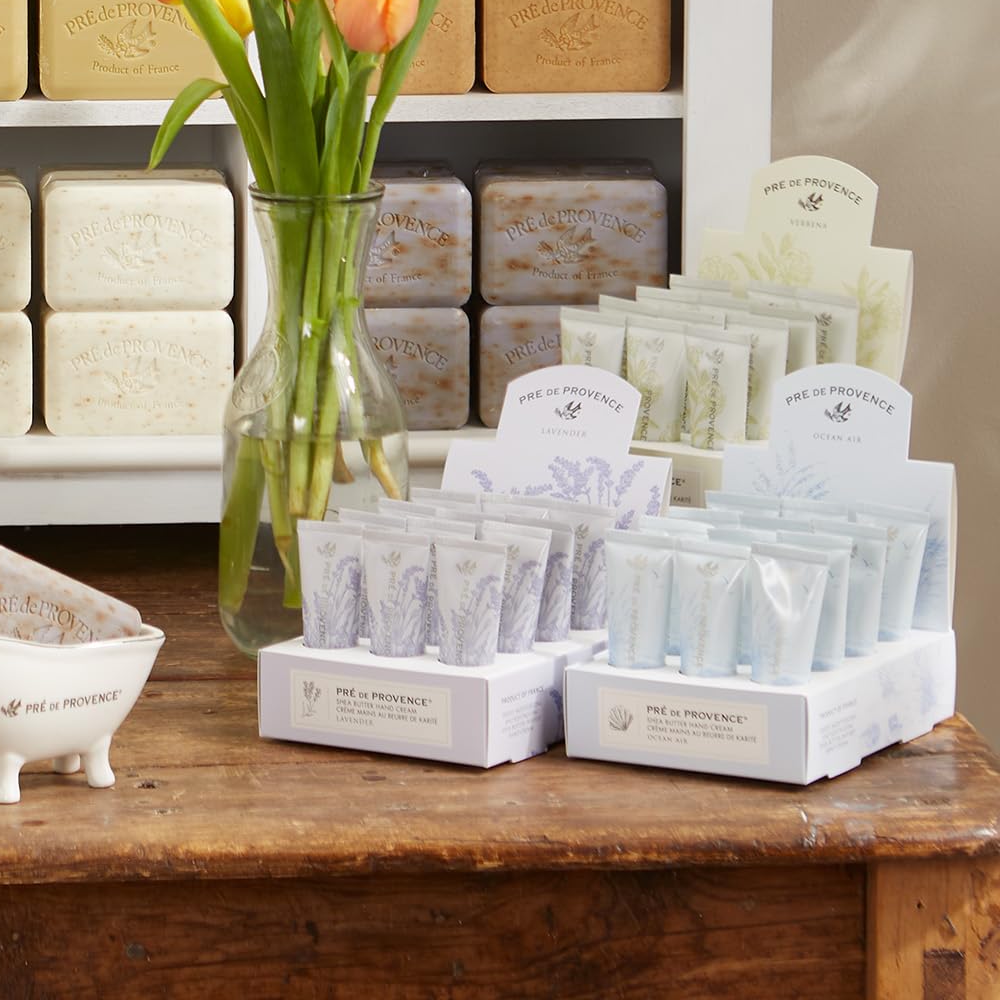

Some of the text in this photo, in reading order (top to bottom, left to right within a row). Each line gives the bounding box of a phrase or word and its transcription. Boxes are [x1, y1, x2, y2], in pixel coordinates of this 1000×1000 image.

[64, 10, 98, 35] PRÉ
[98, 6, 116, 21] de
[93, 60, 179, 74] Product of France
[536, 52, 620, 65] Product of France
[789, 178, 802, 188] DE
[804, 177, 863, 206] PROVENCE
[123, 214, 213, 249] PROVENCE
[539, 210, 554, 226] de
[557, 209, 646, 243] PROVENCE
[376, 273, 423, 283] of France
[533, 266, 618, 279] Product of France
[372, 336, 449, 371] ROVENCE
[546, 387, 560, 397] DE
[563, 385, 624, 414] PROVENCE
[813, 387, 826, 397] DE
[829, 385, 895, 416] PROVENCE
[20, 595, 37, 614] de
[336, 687, 356, 698] PRÉ
[358, 691, 369, 700] DE
[25, 699, 46, 714] PRÉ
[49, 702, 60, 711] DE
[646, 704, 667, 716] PRÉ
[670, 709, 681, 718] DE
